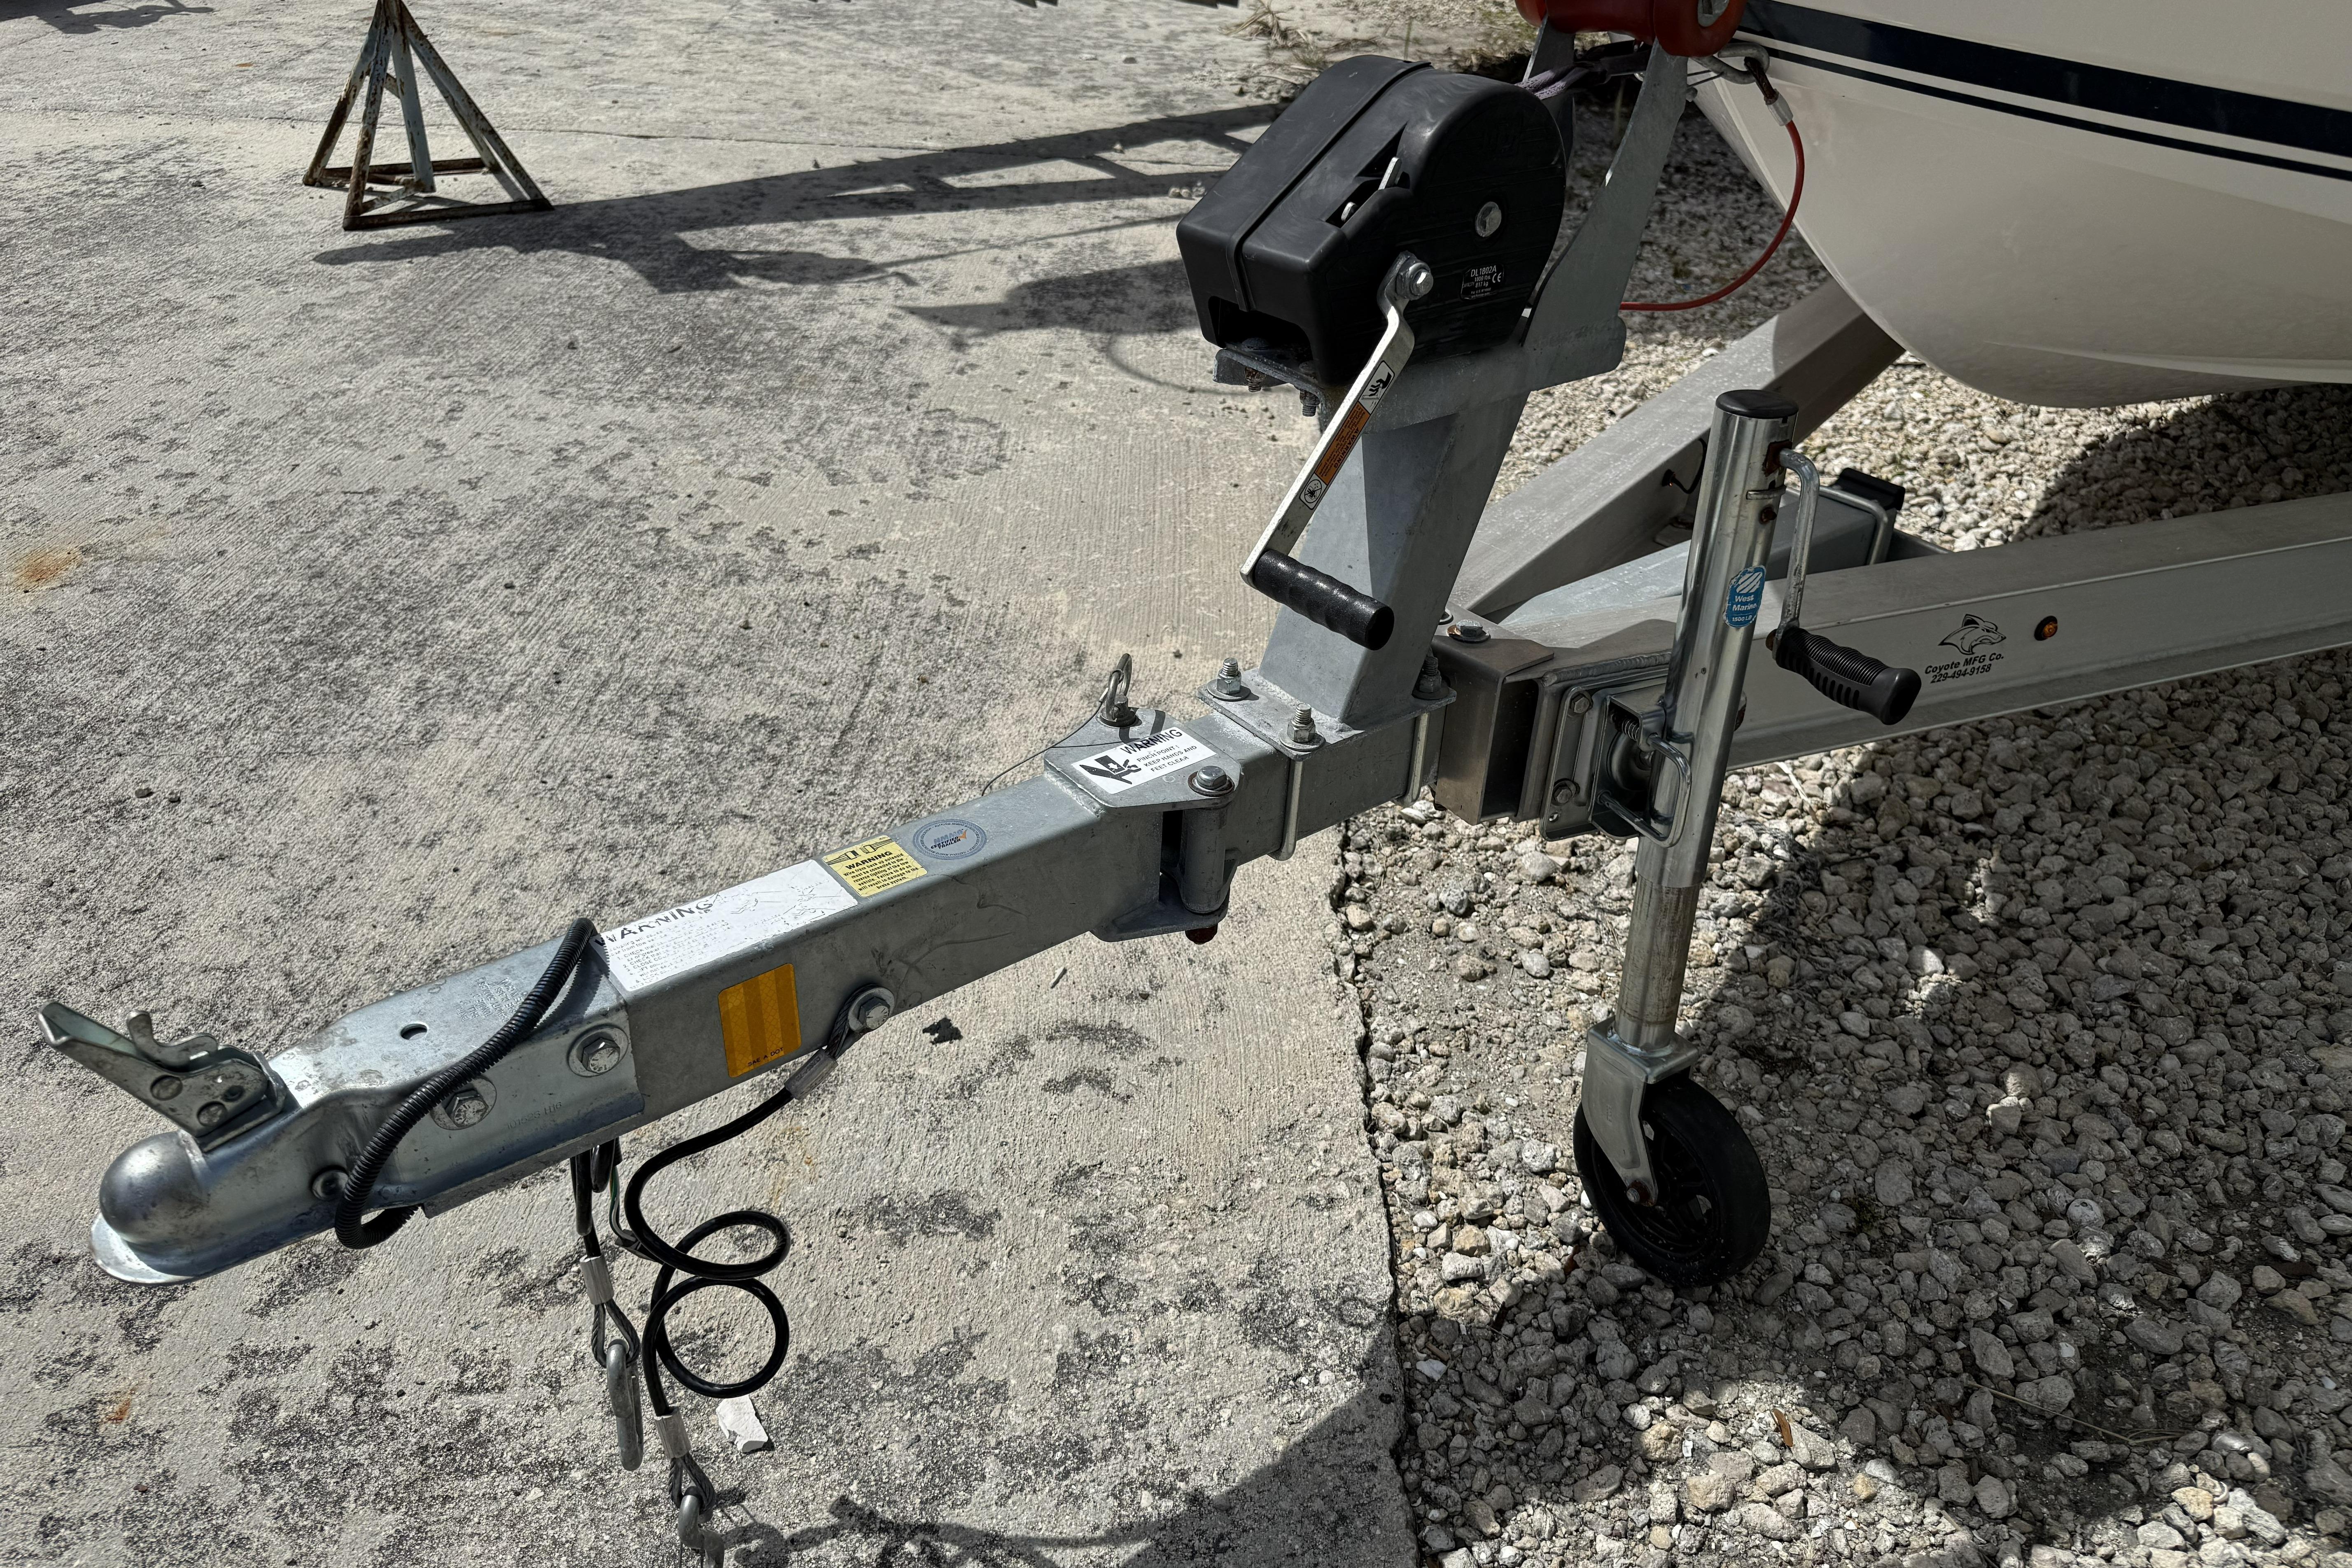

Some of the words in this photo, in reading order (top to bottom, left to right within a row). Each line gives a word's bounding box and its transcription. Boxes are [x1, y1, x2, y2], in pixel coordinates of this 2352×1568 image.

[1334, 434, 1356, 468] WARNING
[1925, 661, 1960, 674] Coyote
[1962, 655, 1986, 667] MFG
[1989, 653, 2004, 661] Co.
[1930, 663, 1992, 684] 229-494-9158
[1120, 730, 1182, 754] WARNING
[1136, 753, 1157, 762] PINCH
[1158, 746, 1175, 755] POINT
[1144, 758, 1160, 767] KEEP
[1162, 751, 1183, 761] HANDS
[1151, 764, 1167, 772] FEET
[1167, 756, 1189, 766] CLEAR
[931, 836, 959, 849] CERTIFIED
[938, 838, 961, 849] TRAILER
[845, 851, 893, 869] WARNING
[884, 853, 904, 862] solenoid
[870, 862, 891, 872] connected
[887, 872, 905, 880] damage
[594, 900, 713, 947] WARNING
[748, 1057, 761, 1066] SAE
[771, 1047, 784, 1056] DOT
